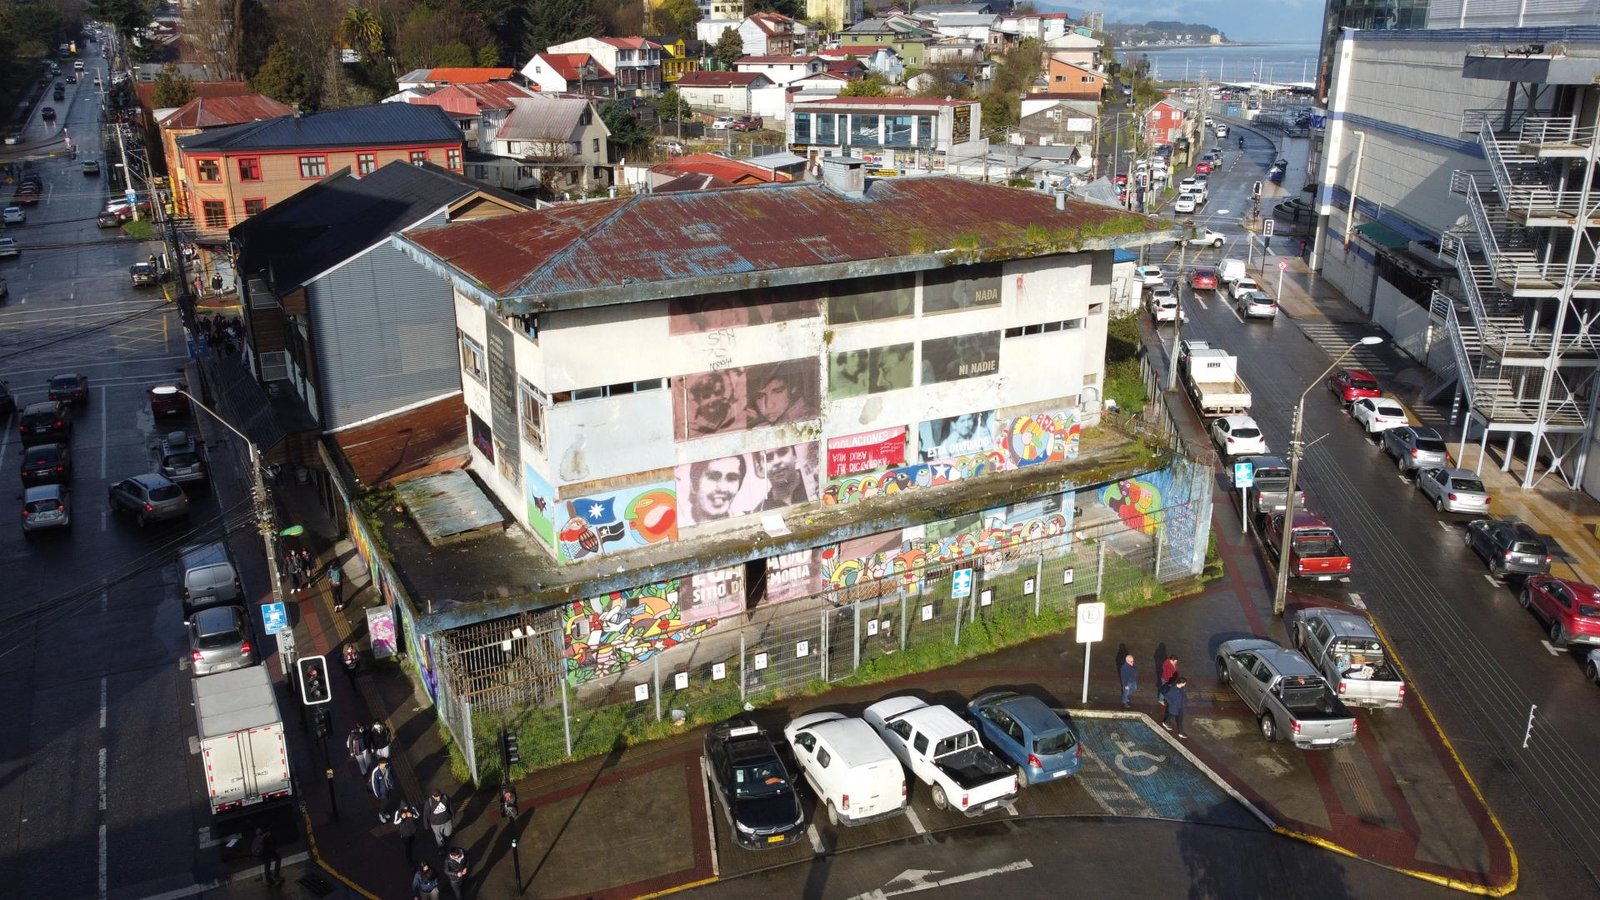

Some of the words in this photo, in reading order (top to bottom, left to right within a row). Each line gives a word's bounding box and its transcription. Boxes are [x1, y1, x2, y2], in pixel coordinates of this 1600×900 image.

[975, 288, 998, 301] NADA
[959, 364, 968, 375] NI
[971, 360, 996, 373] NADIE
[692, 583, 727, 603] SITIO
